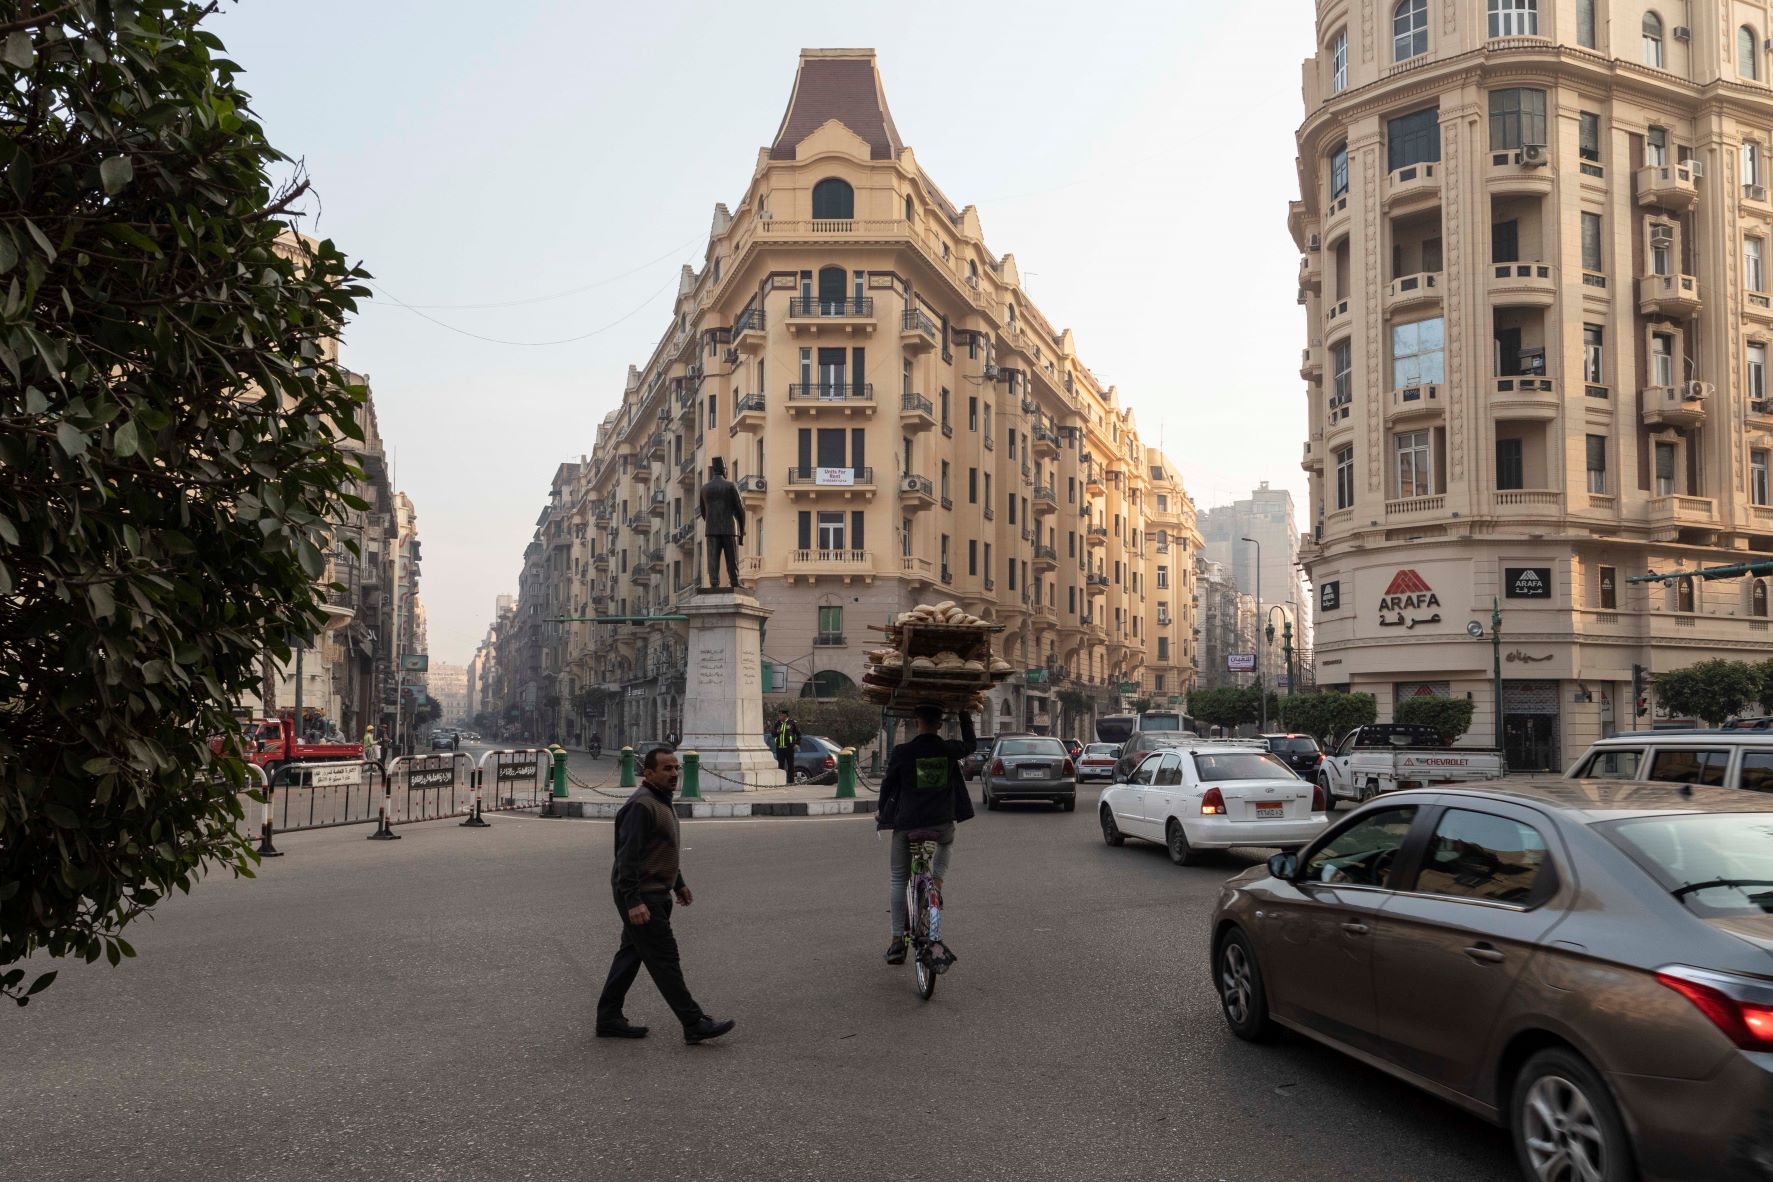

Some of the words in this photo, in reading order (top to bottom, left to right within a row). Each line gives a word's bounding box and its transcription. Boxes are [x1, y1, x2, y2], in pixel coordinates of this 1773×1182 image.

[1515, 587, 1543, 595] عرفة
[1379, 593, 1441, 612] ARAFA
[1379, 612, 1441, 630] عرفة
[1426, 758, 1469, 766] CHEVROLET
